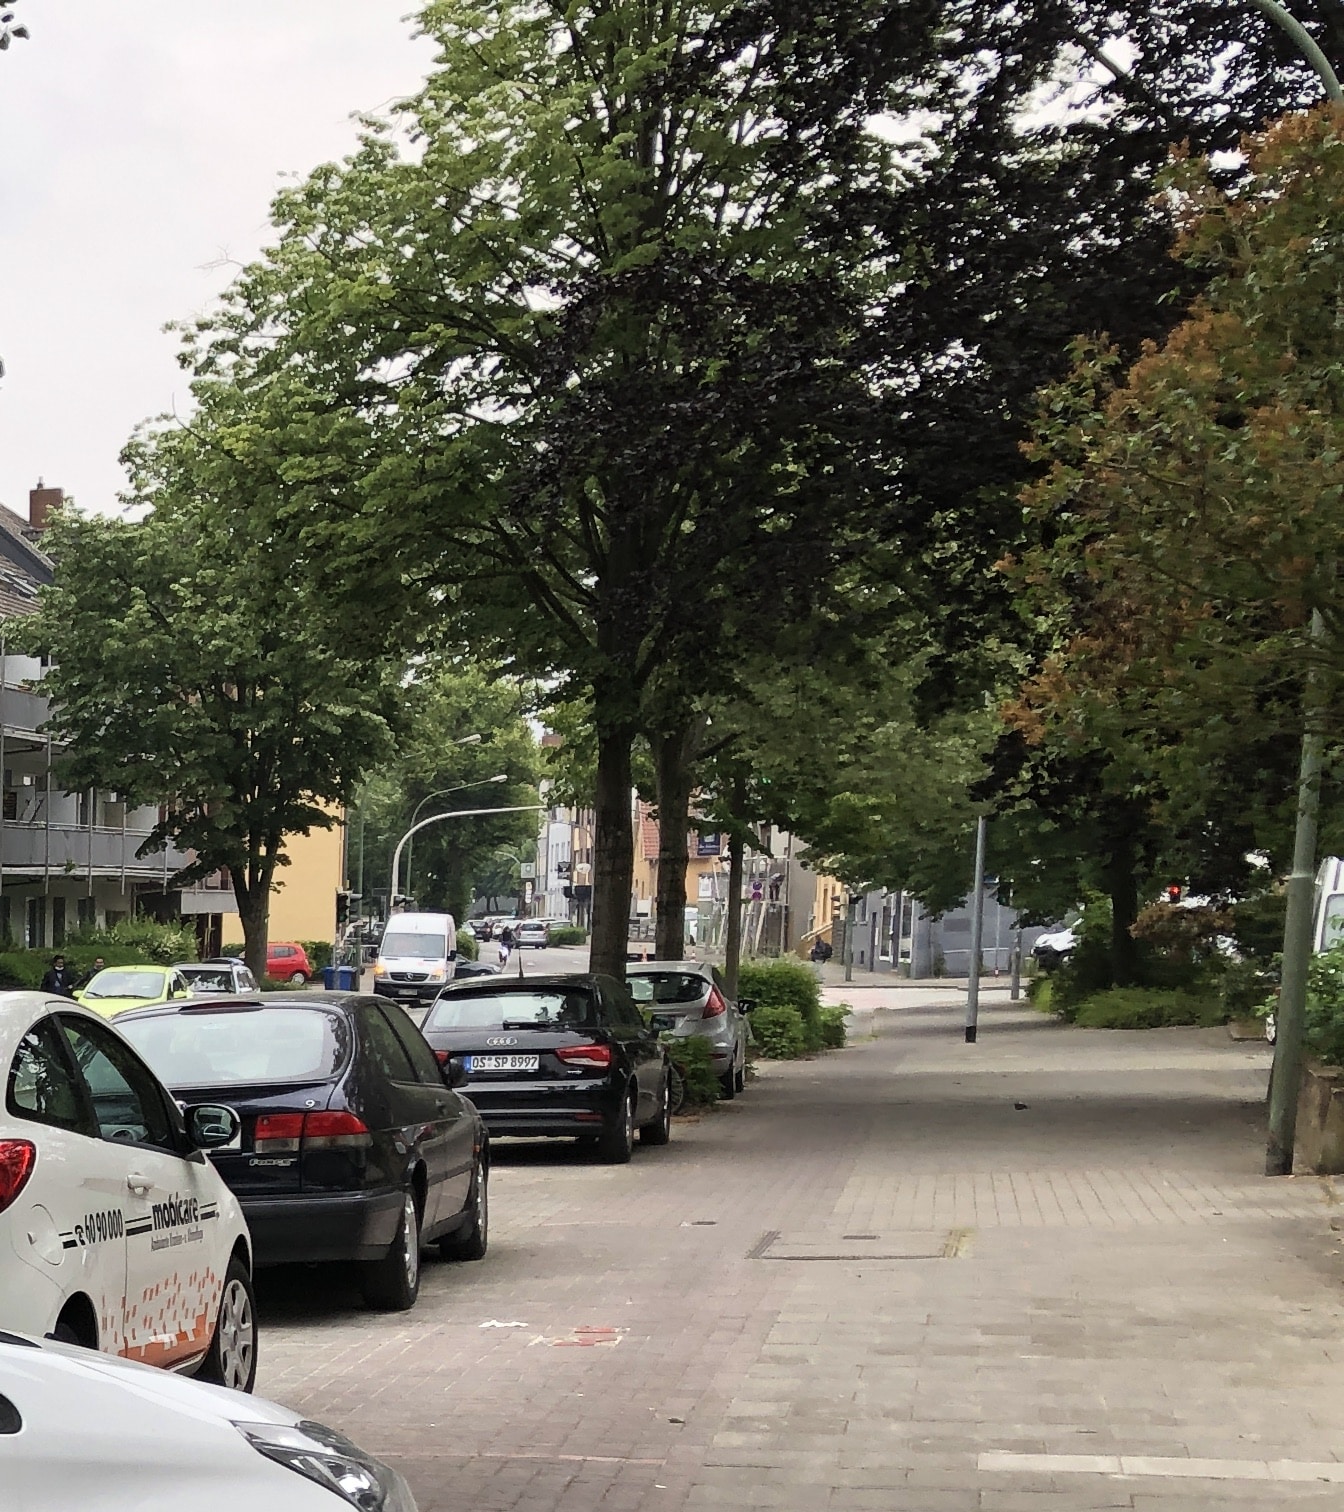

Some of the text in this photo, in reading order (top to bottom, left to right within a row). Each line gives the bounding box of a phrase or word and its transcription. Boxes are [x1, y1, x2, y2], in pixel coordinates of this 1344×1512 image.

[472, 1055, 538, 1068] OS SP 8997
[108, 1208, 123, 1241] 000
[152, 1191, 199, 1231] mobicare
